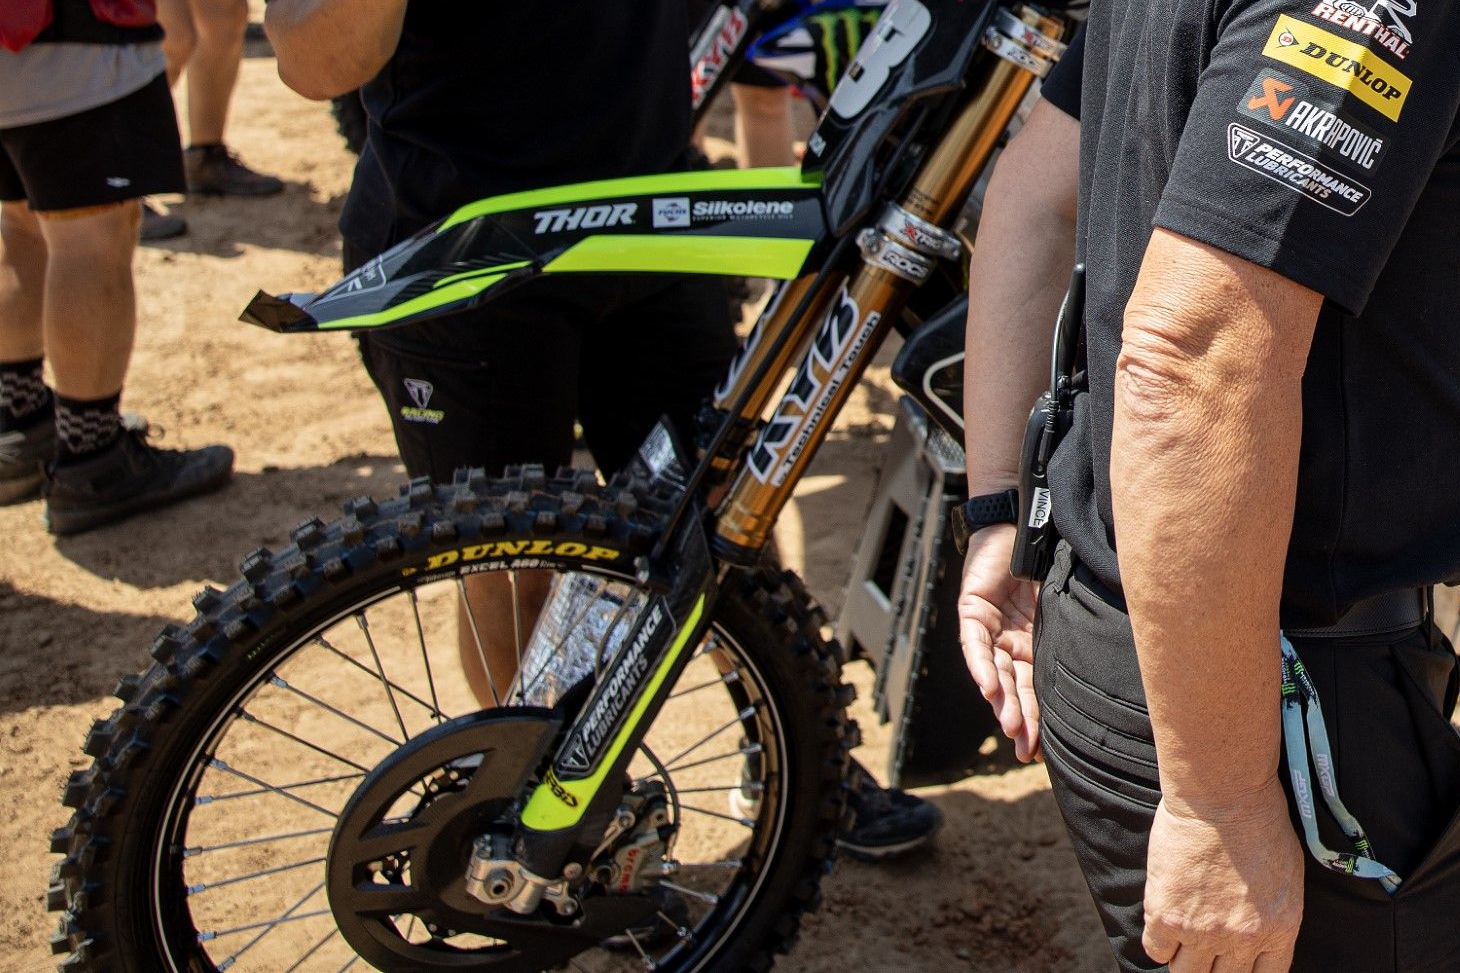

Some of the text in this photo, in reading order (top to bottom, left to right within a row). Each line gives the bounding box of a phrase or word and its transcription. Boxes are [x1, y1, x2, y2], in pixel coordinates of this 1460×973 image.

[1311, 2, 1410, 60] RENTHAL
[1300, 41, 1402, 103] DUNLOP
[1245, 152, 1333, 199] LUBRICANTS
[1254, 142, 1364, 203] PERFORMANCE
[534, 203, 639, 234] THOR
[693, 200, 794, 216] Silkolene
[784, 379, 842, 468] Technical
[1033, 490, 1050, 526] VINCE
[427, 540, 621, 571] DUNLOP
[582, 604, 664, 741] PERFORMANCE
[587, 655, 650, 756] LUBRICANTS
